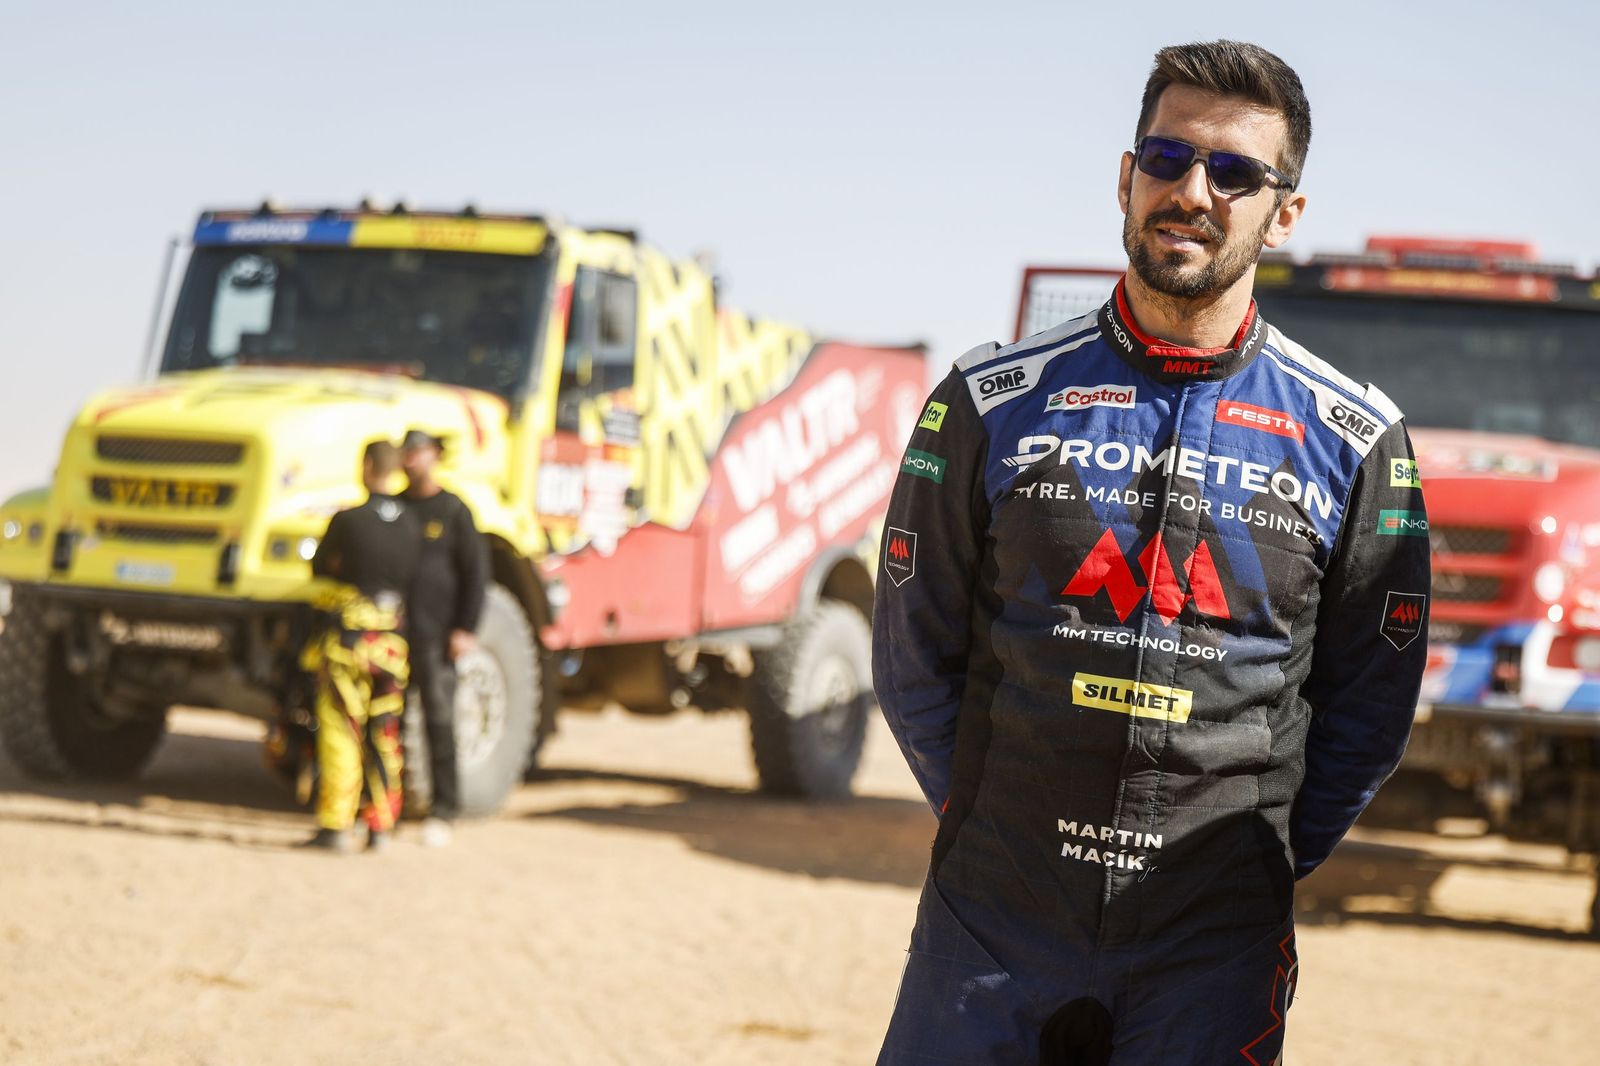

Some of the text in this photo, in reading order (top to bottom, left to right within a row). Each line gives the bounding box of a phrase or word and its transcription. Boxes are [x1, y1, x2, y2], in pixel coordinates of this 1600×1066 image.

[1162, 360, 1215, 375] MMT
[979, 370, 1026, 395] OMP
[1065, 389, 1133, 406] Castrol
[1227, 407, 1298, 434] FESTA
[1330, 405, 1376, 438] OMP
[1002, 434, 1333, 521] PROMETEON
[1085, 485, 1156, 508] MADE
[1167, 492, 1212, 516] FOR
[1221, 502, 1325, 545] BUSINESS
[1052, 624, 1228, 662] MM TECHNOLOGY
[1083, 683, 1179, 712] SILMET
[1057, 819, 1163, 849] MARTIN
[1061, 842, 1145, 871] MACÍK
